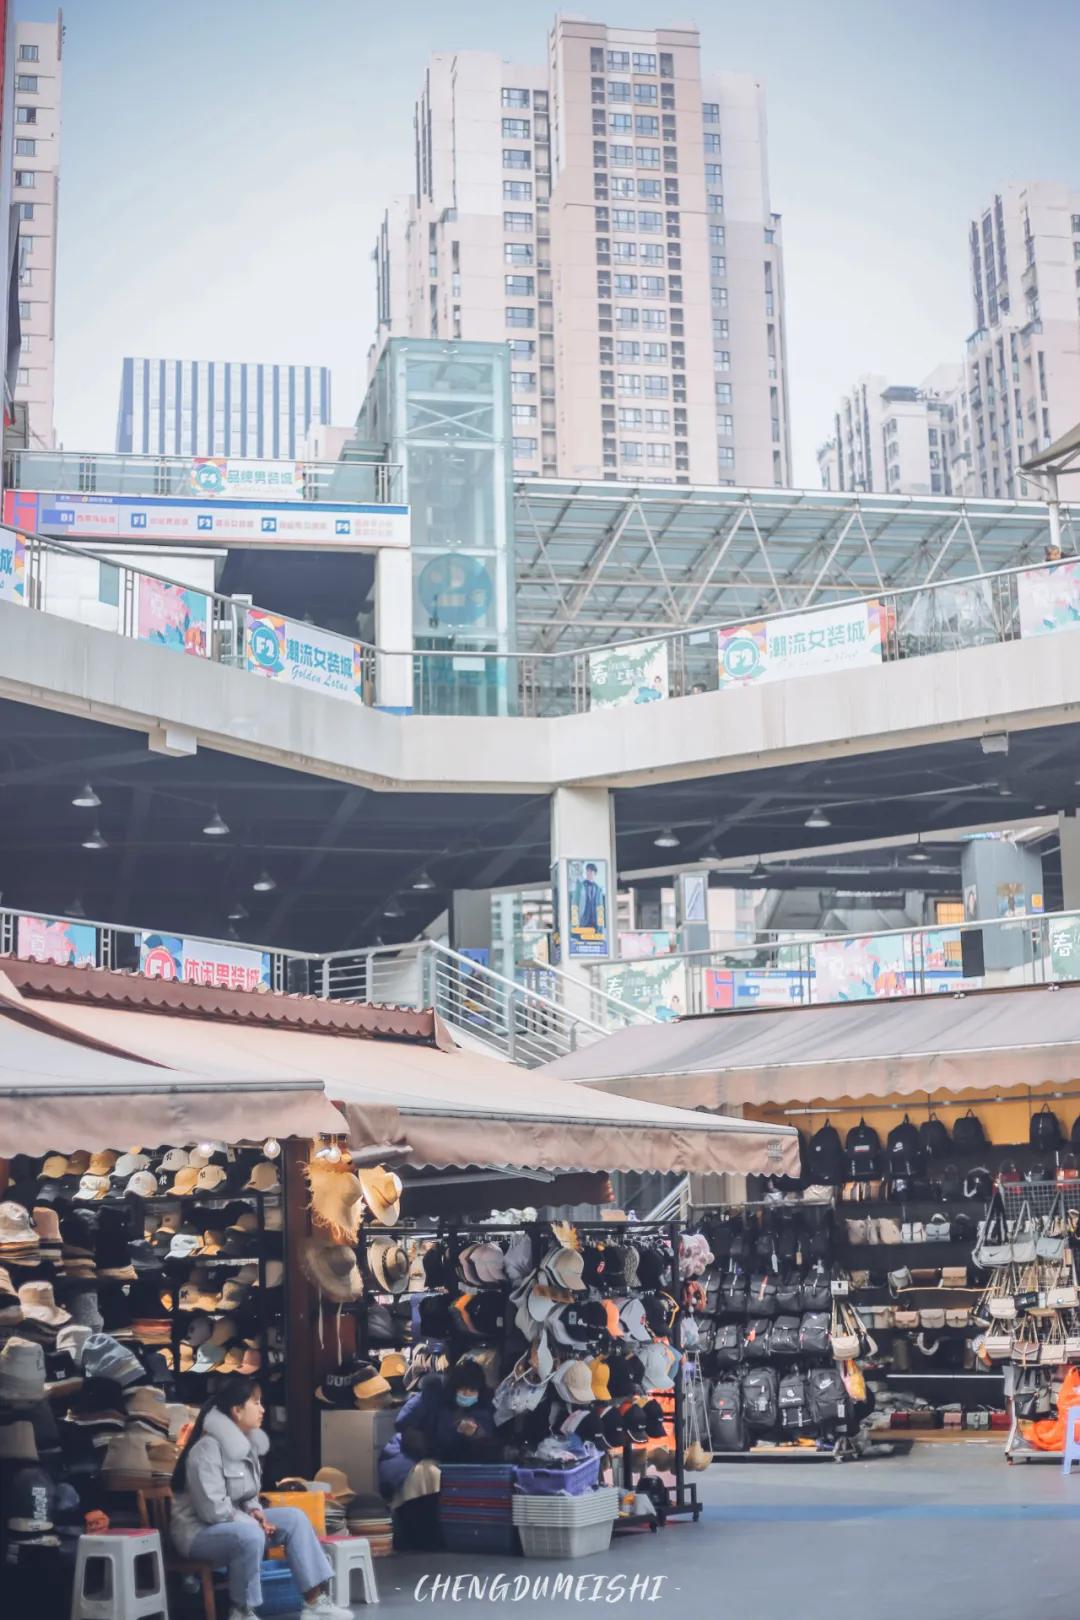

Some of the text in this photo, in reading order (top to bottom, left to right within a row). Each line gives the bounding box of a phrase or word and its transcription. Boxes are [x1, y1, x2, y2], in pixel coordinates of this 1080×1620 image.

[256, 636, 275, 659] F2
[769, 620, 866, 659] 潮流女装城
[287, 638, 353, 679] 潮流女装城
[729, 648, 753, 669] F2
[291, 664, 348, 692] Golden Lotus
[184, 958, 261, 992] 休闲男装城
